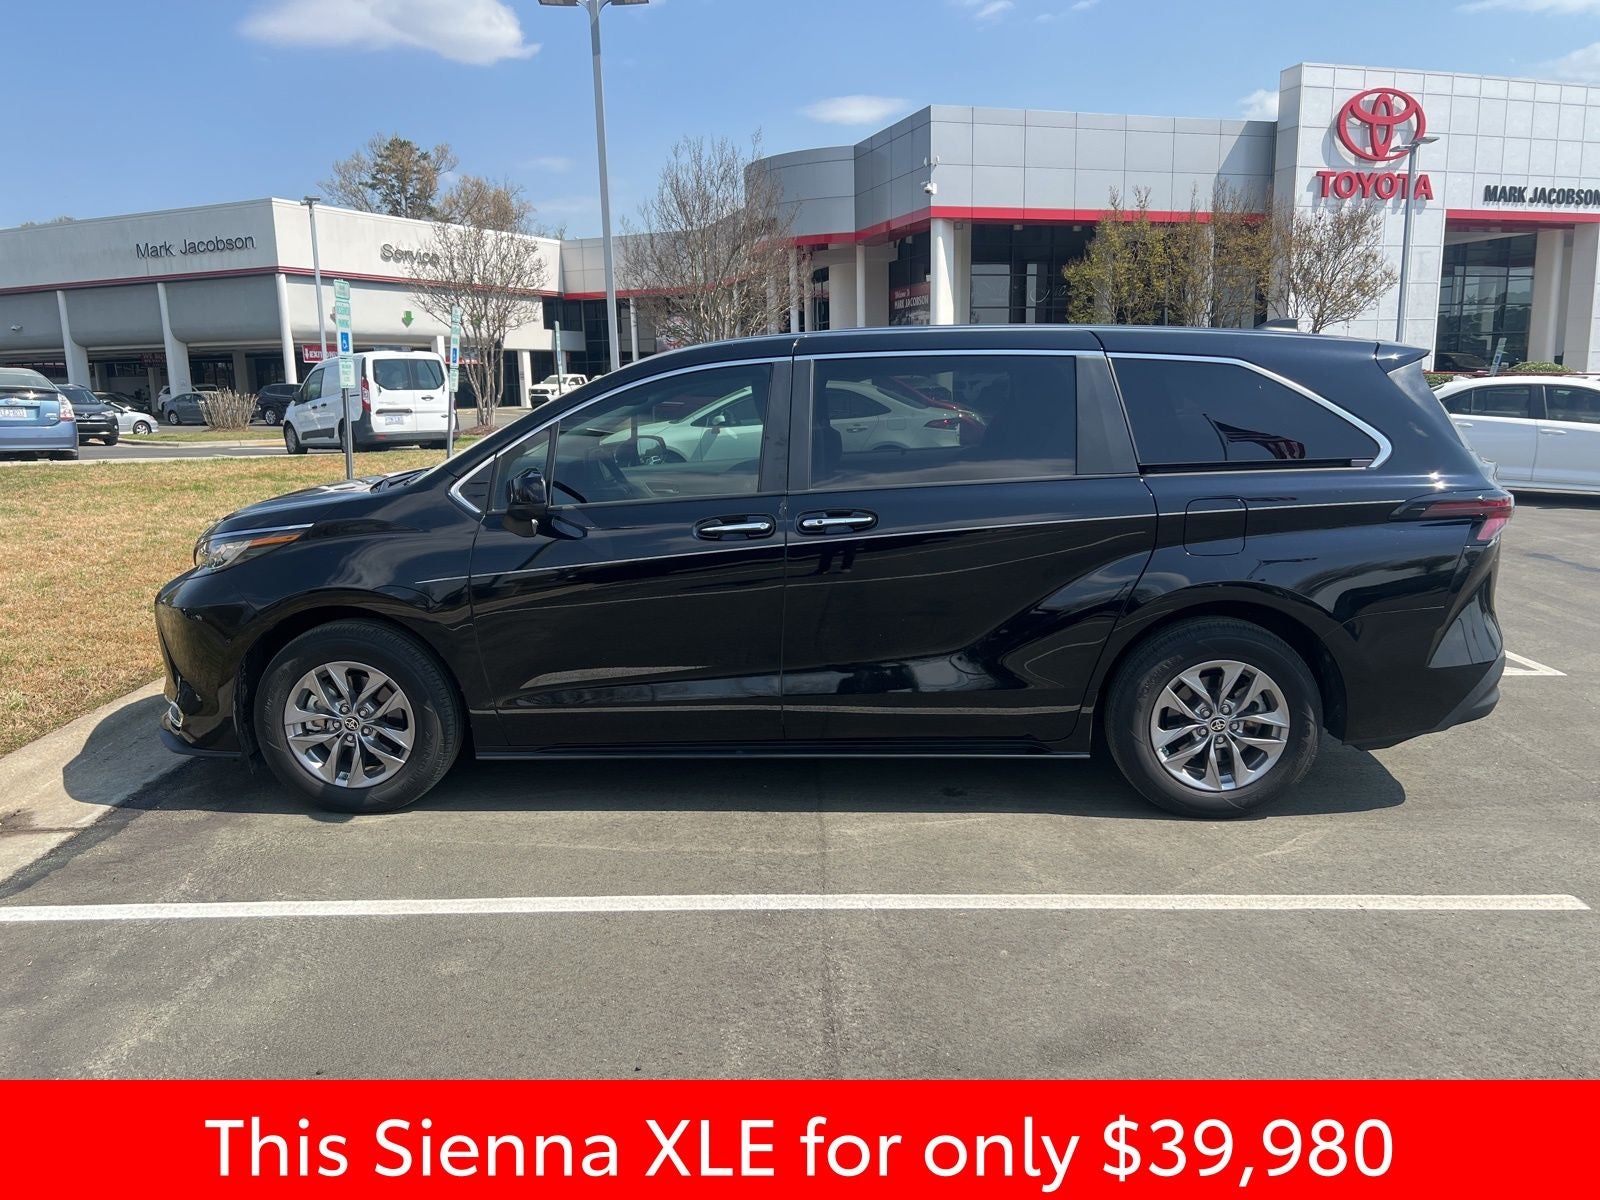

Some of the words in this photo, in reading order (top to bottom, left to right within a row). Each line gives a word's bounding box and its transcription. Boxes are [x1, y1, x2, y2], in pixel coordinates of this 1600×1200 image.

[1316, 170, 1434, 201] TOYOTA
[1483, 184, 1527, 203] MARK
[136, 241, 175, 259] Mark
[180, 235, 254, 255] Jacobson
[381, 243, 440, 265] Service
